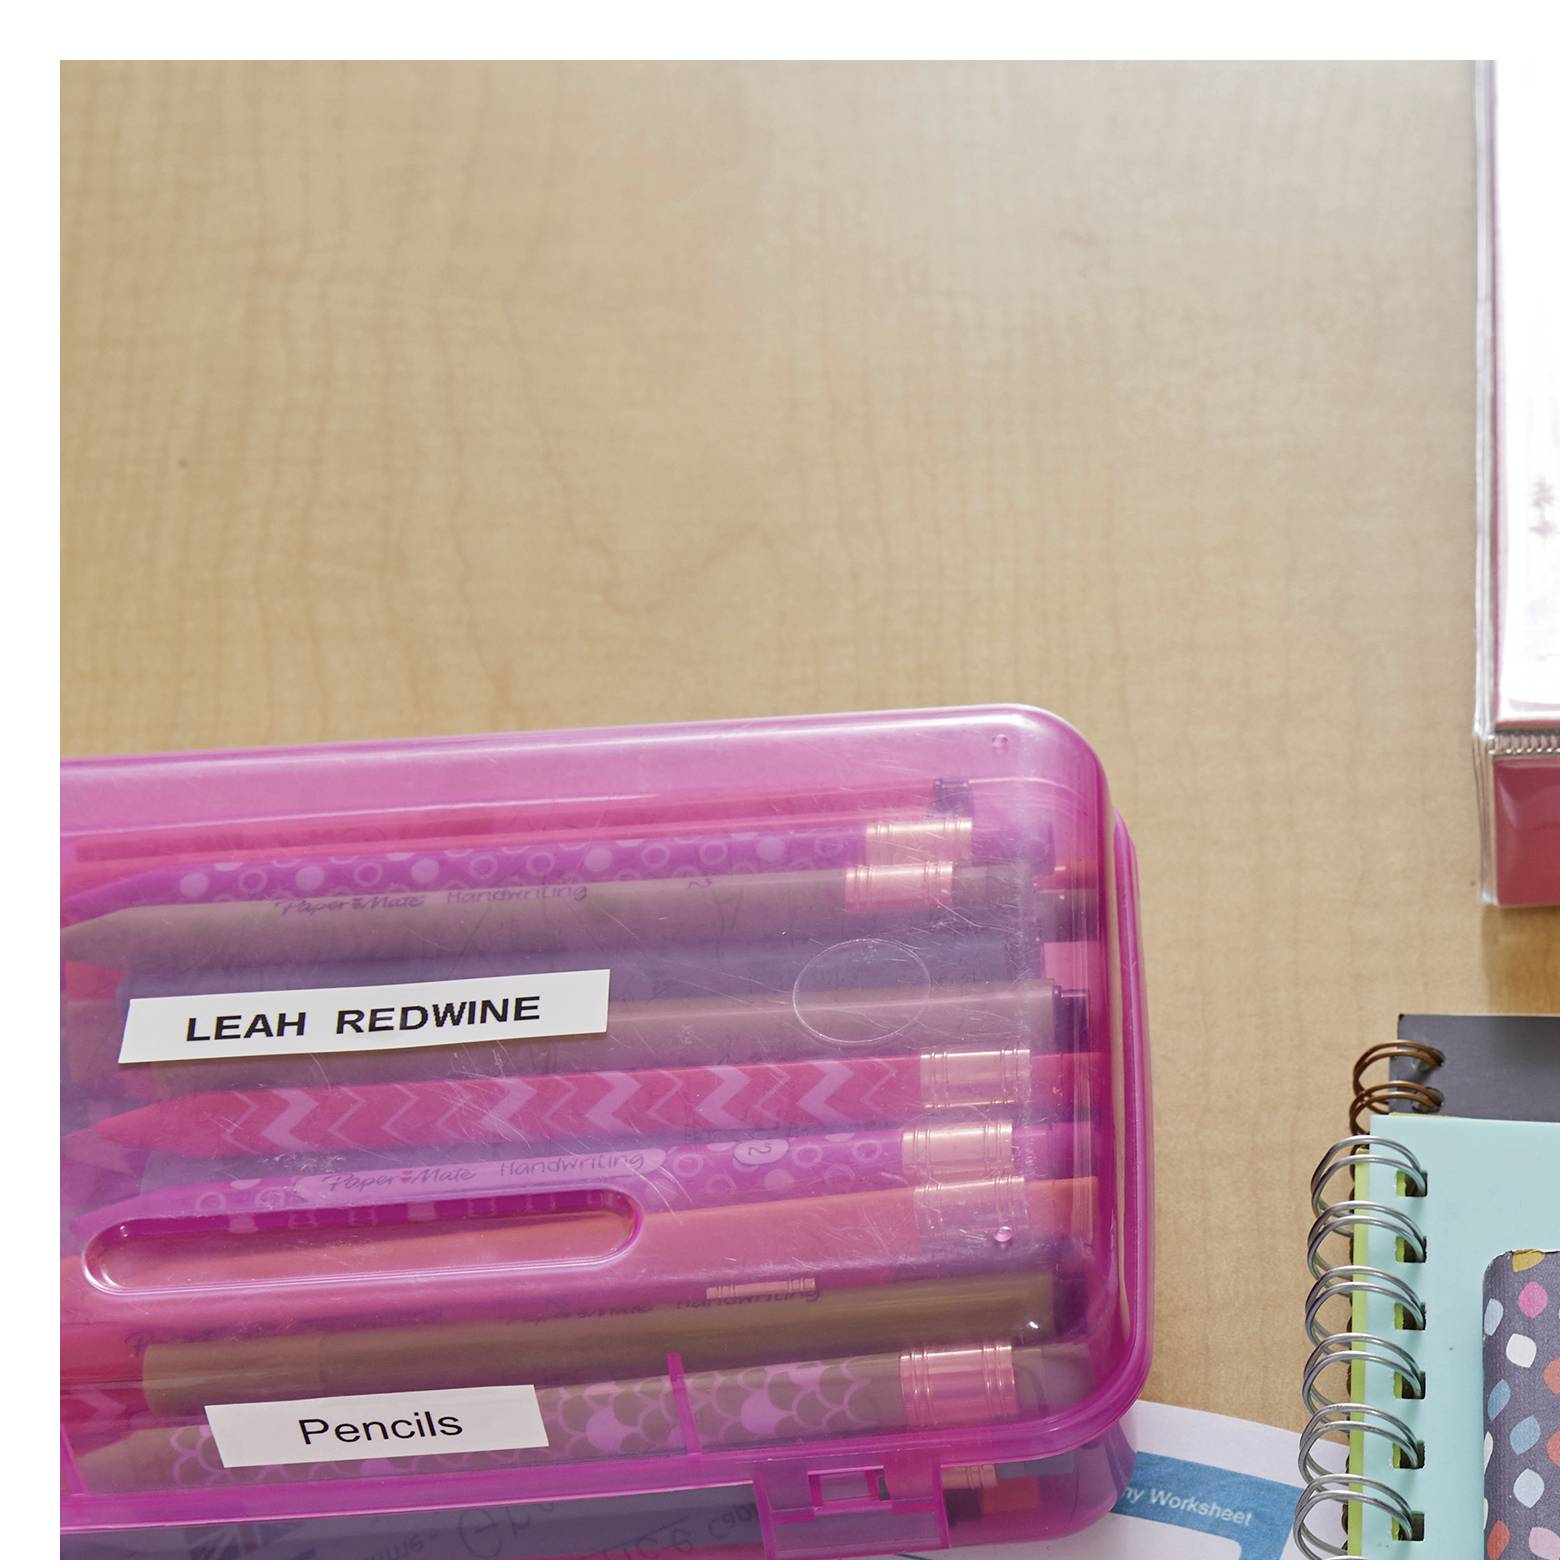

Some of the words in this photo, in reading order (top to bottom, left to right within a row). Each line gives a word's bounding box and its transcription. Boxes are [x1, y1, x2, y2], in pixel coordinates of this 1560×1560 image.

[185, 1011, 307, 1042] LEAH
[335, 995, 541, 1036] REDWINE
[298, 1410, 464, 1446] Pencils
[1150, 1487, 1253, 1527] Worksheet
